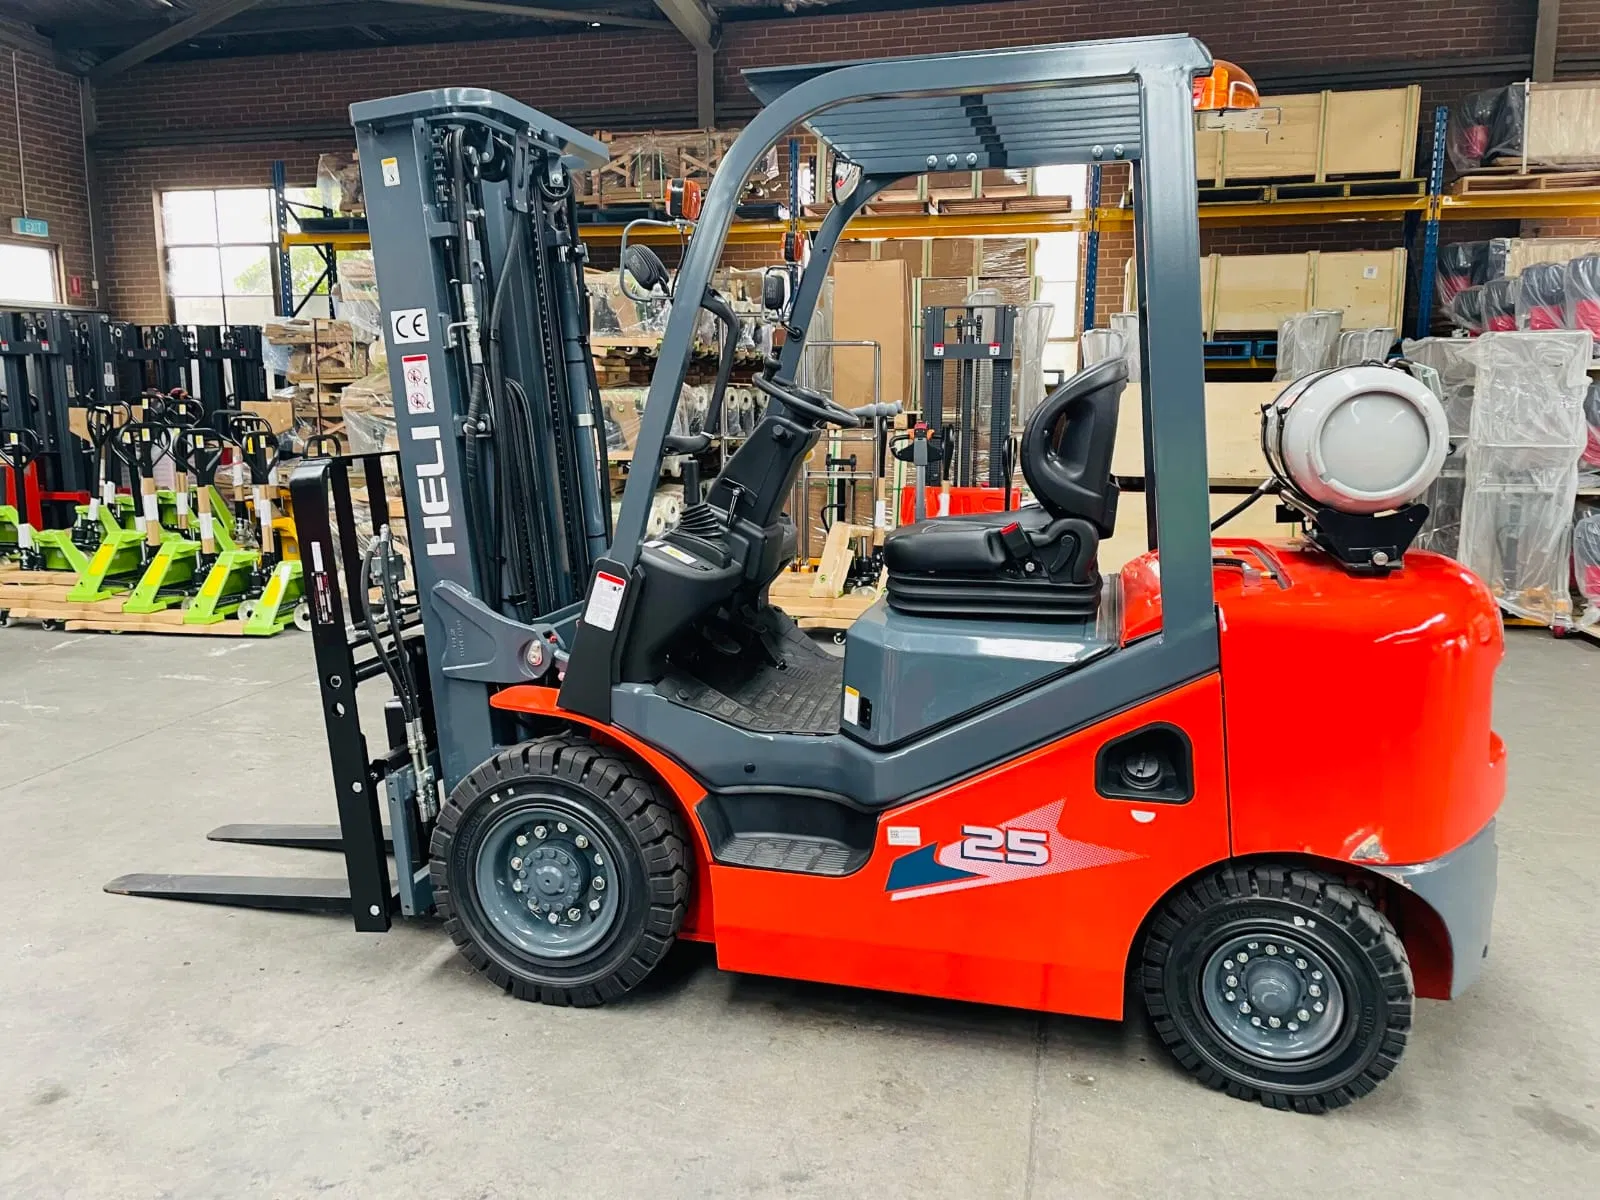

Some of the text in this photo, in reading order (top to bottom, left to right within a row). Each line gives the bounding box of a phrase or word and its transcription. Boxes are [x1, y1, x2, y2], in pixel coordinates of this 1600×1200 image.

[25, 221, 42, 233] EXIT
[396, 313, 426, 339] CE
[411, 425, 456, 556] HELI
[961, 824, 1050, 866] 25
